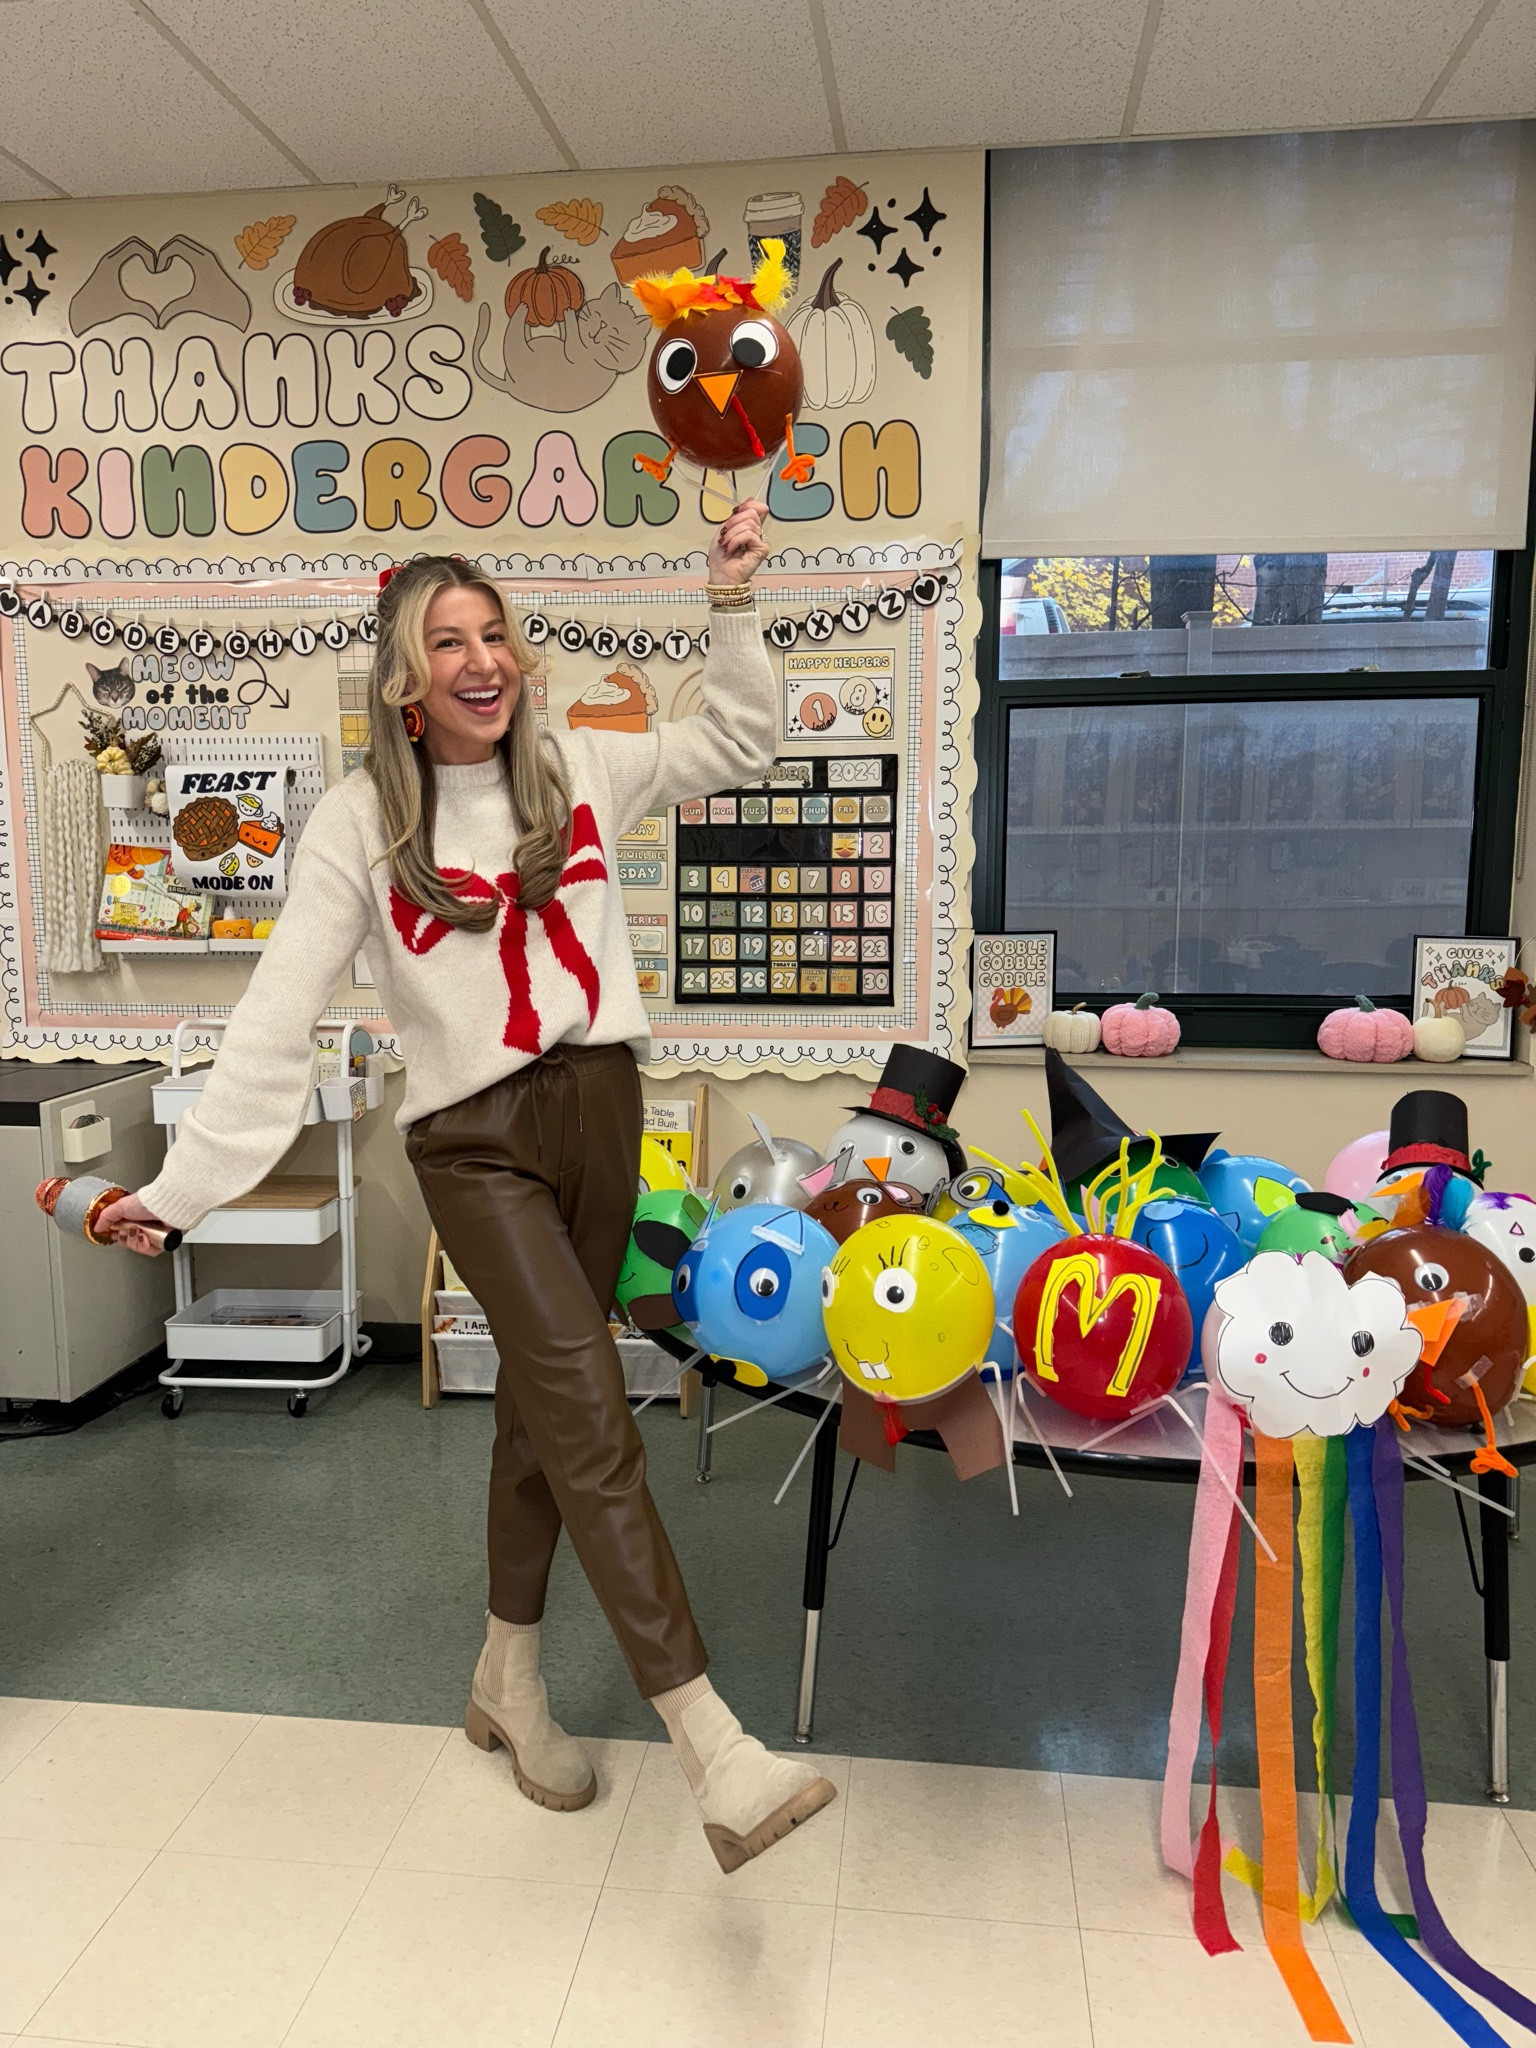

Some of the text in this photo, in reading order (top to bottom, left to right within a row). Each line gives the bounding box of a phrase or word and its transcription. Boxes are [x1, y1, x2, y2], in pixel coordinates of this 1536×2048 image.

[1, 325, 472, 433] THANKS
[773, 592, 902, 644] W X Y Z
[31, 605, 378, 655] A B C D E F G H I J K
[528, 618, 544, 638] P
[563, 626, 582, 648] Q
[597, 631, 614, 653] R
[632, 634, 648, 655] S
[669, 635, 685, 656] T
[132, 653, 236, 683] MEOW
[789, 656, 889, 669] HAPPY HELPERS
[146, 683, 229, 704] of the
[850, 684, 866, 707] 8
[122, 705, 251, 730] MOMENT
[812, 699, 824, 722] 1
[755, 762, 880, 781] MBER 2024
[180, 771, 277, 794] FEAST
[870, 835, 884, 854] 2
[626, 851, 649, 860] WILL
[192, 875, 244, 890] MODE
[248, 874, 274, 890] ON
[687, 870, 699, 888] 3
[716, 870, 729, 888] 4
[777, 870, 791, 889] 6
[807, 870, 820, 889] 7
[839, 870, 852, 889] 8
[871, 870, 884, 889] 9
[682, 904, 703, 923] 10
[743, 904, 764, 923] 12
[774, 904, 794, 924] 13
[803, 904, 825, 924] 14
[833, 904, 855, 923] 15
[866, 904, 889, 924] 16
[684, 937, 887, 957] 17 18 19 20 21 22 23
[980, 940, 1047, 955] GOBBLE
[1446, 947, 1484, 959] GIVE
[979, 955, 1046, 971] GOBBLE
[683, 971, 707, 989] 24
[711, 971, 735, 989] 25
[742, 971, 766, 989] 26
[772, 972, 796, 989] 27
[864, 973, 888, 990] 30
[979, 971, 1046, 987] GOBBLE
[1421, 960, 1504, 991] THANKS
[650, 1106, 675, 1118] Table
[657, 1118, 679, 1129] Built
[464, 1321, 489, 1329] I Am
[1035, 1251, 1161, 1397] M
